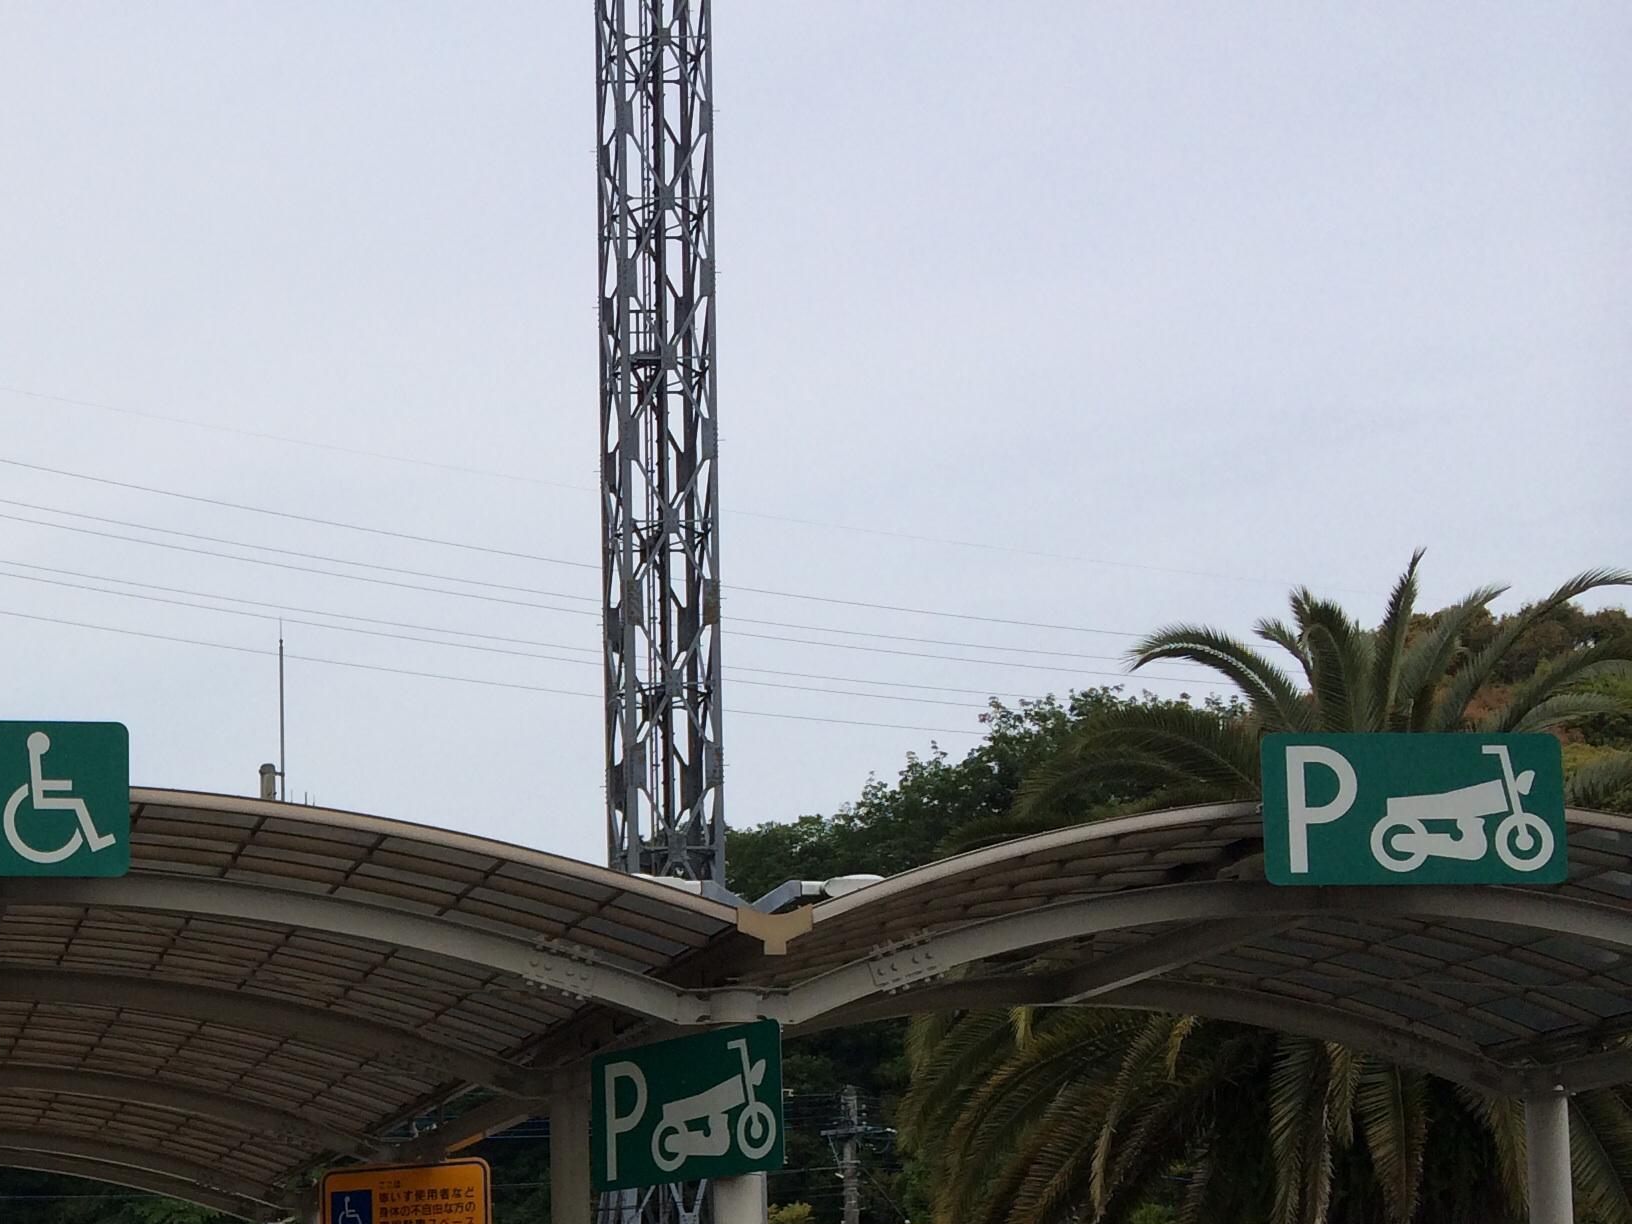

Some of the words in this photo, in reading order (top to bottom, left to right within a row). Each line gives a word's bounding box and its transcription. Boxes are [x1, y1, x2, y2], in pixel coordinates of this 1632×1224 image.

[1285, 745, 1358, 873] P
[604, 1060, 648, 1182] P
[378, 1201, 476, 1218] 身体の不自由な方の
